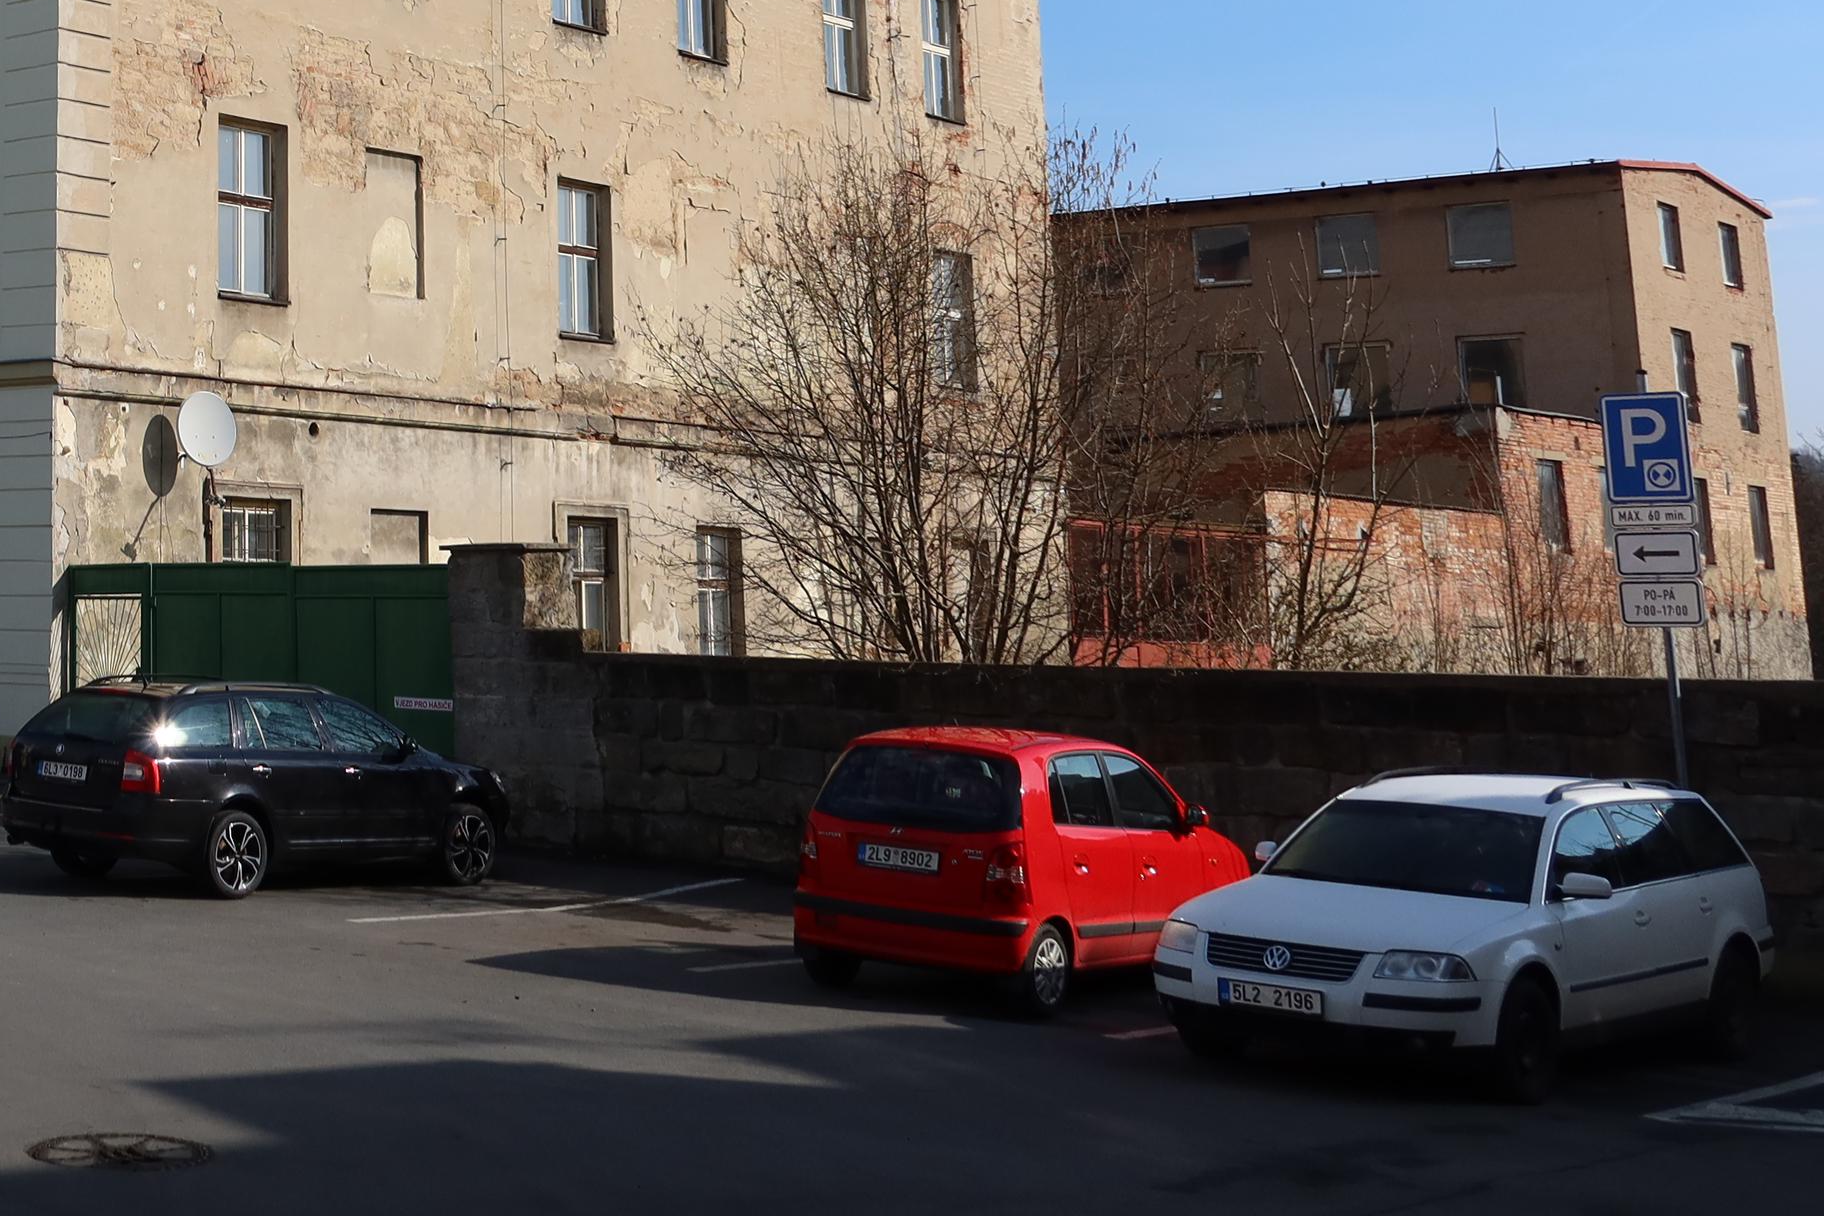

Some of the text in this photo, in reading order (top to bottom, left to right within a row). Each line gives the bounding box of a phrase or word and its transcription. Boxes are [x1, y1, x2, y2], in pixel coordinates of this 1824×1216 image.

[1620, 408, 1666, 467] P
[1618, 509, 1687, 522] MAX. 60 min.
[1643, 586, 1676, 601] PO-PÁ
[1635, 604, 1688, 617] 7:00-17:00
[396, 698, 414, 708] VJEZD
[415, 699, 428, 709] PRO
[43, 762, 83, 778] 6L3 0198
[867, 846, 933, 868] 2L9 8902
[1232, 984, 1314, 1011] 5L2 2196
